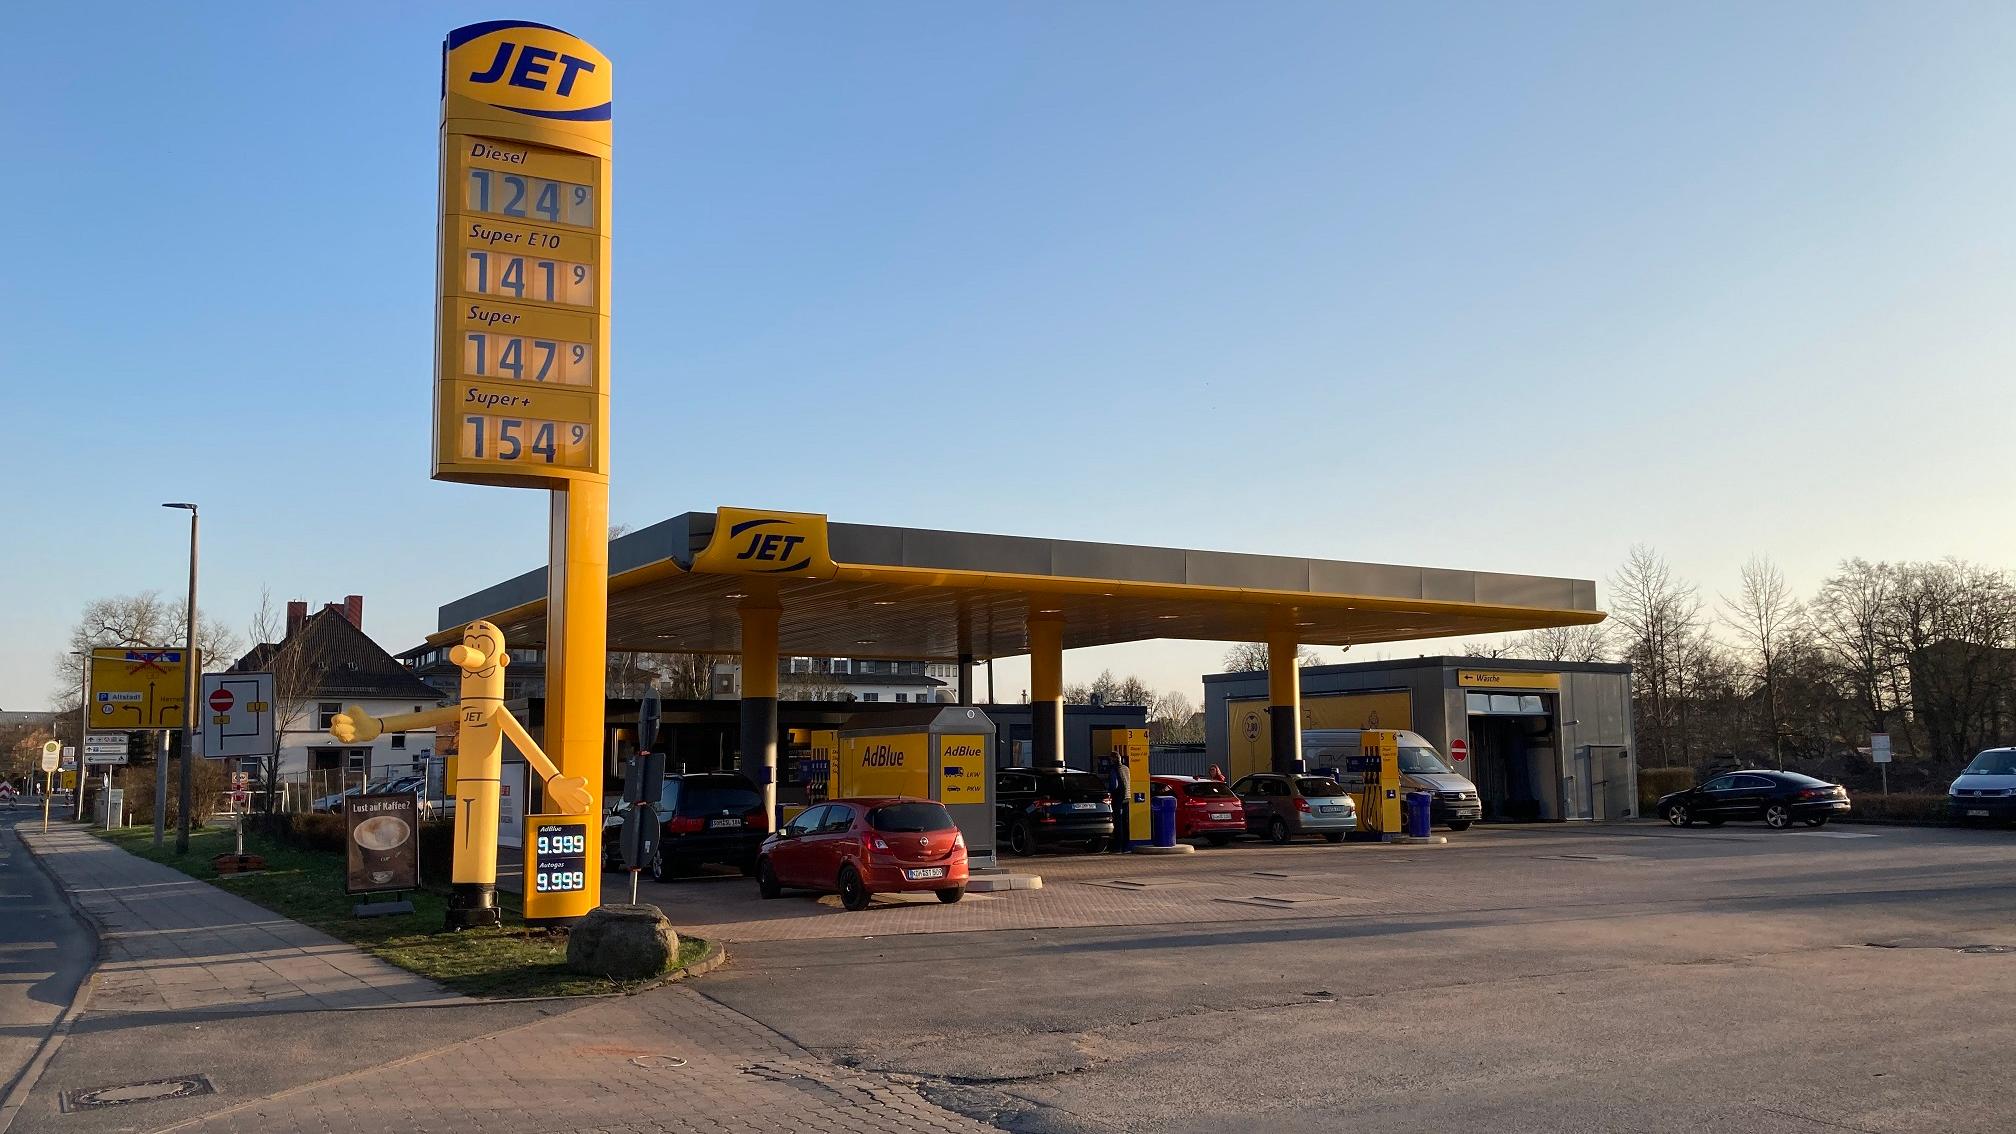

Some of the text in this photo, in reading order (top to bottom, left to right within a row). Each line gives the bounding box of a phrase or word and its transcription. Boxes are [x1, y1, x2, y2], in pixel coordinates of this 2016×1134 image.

[469, 41, 596, 97] JET
[470, 143, 528, 165] Diesel
[469, 224, 561, 249] Super E10
[467, 305, 521, 326] Super
[465, 388, 531, 408] Super+
[736, 533, 806, 562] JET
[463, 711, 484, 722] JET
[1128, 731, 1133, 739] 3
[1380, 733, 1397, 741] 5 6
[862, 744, 904, 767] AdBlue
[944, 746, 982, 757] AdBlue
[353, 801, 411, 813] Lust auf Kaffee?
[537, 835, 584, 854] 9.999
[537, 871, 583, 891] 9.999
